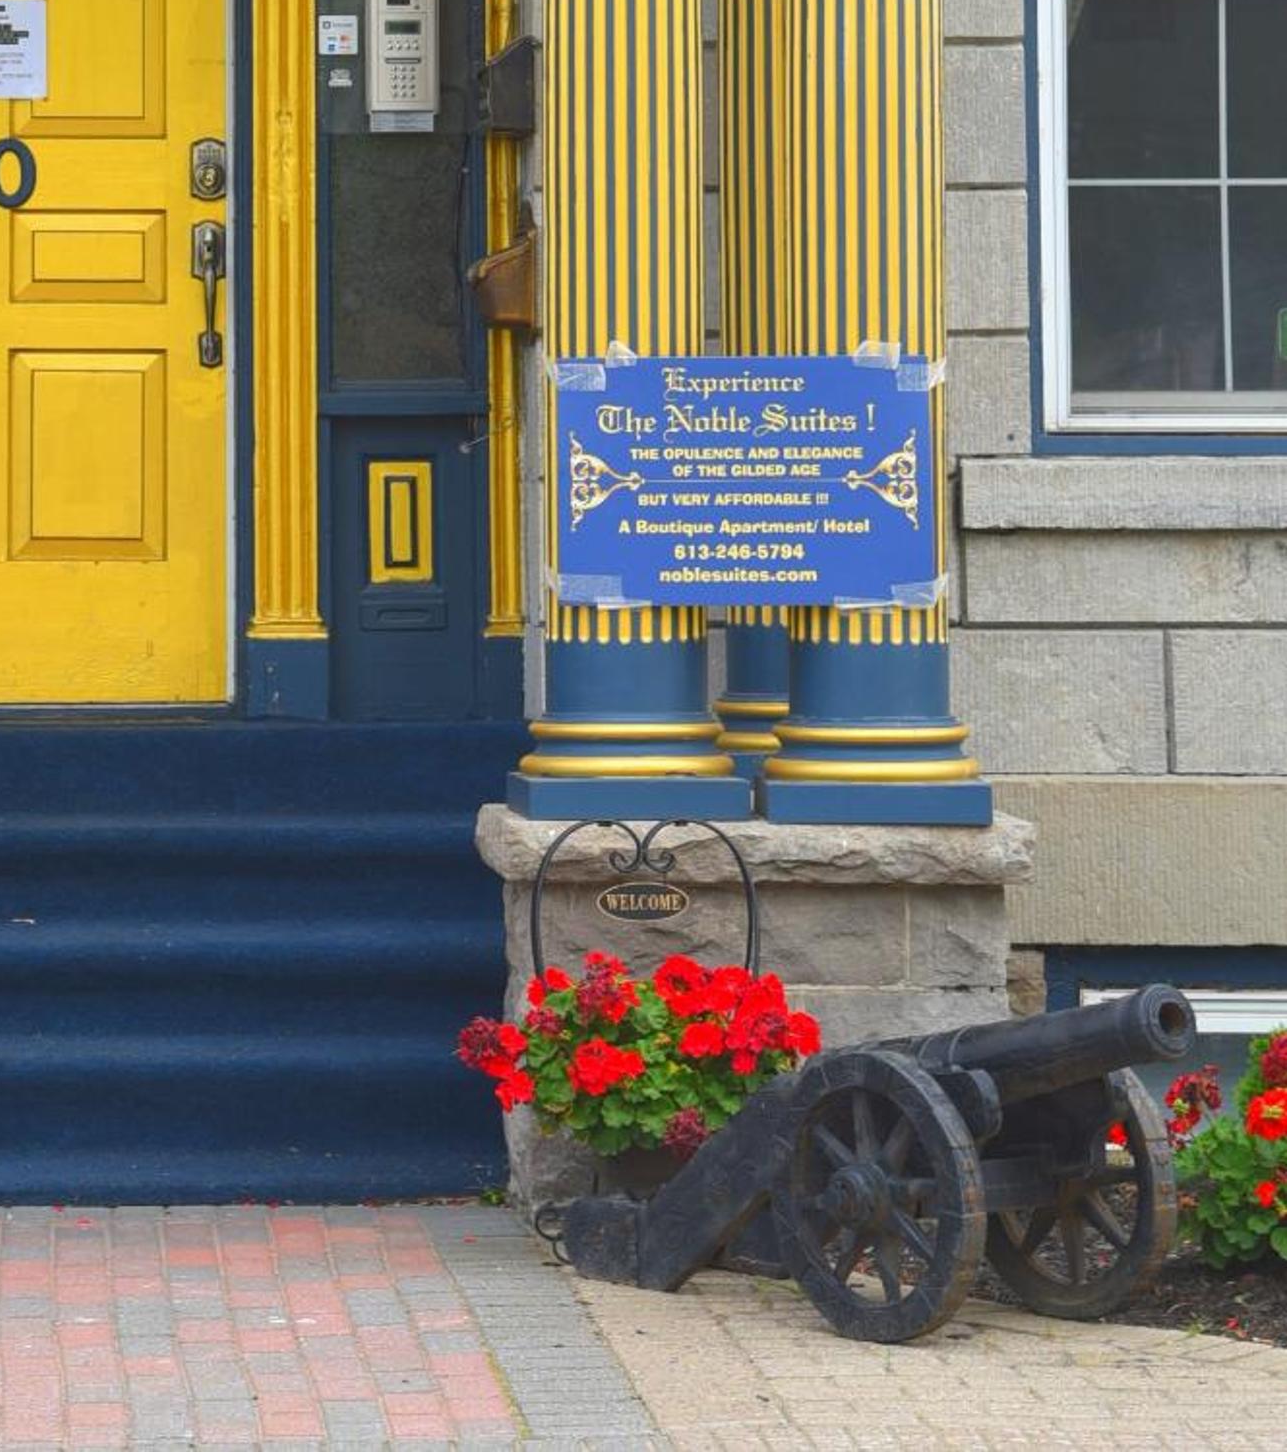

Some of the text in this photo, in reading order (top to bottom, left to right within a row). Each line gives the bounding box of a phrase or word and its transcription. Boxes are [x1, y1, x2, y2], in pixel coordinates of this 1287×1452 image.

[661, 367, 805, 401] Experience
[595, 404, 657, 441] The
[663, 404, 751, 443] Noble
[752, 403, 857, 437] Suites
[629, 446, 863, 461] THE OPULENCE AND ELEGANCE
[672, 463, 821, 478] OF THE GILDED AGE
[637, 493, 668, 507] BUT
[671, 493, 711, 507] VERY
[714, 492, 813, 506] AFFORDABLE
[618, 518, 870, 535] A Boutique Apartment/ Hotel
[673, 543, 805, 560] 613-246-5794
[659, 566, 818, 583] noblesuites.com
[606, 894, 683, 911] WELCOME
